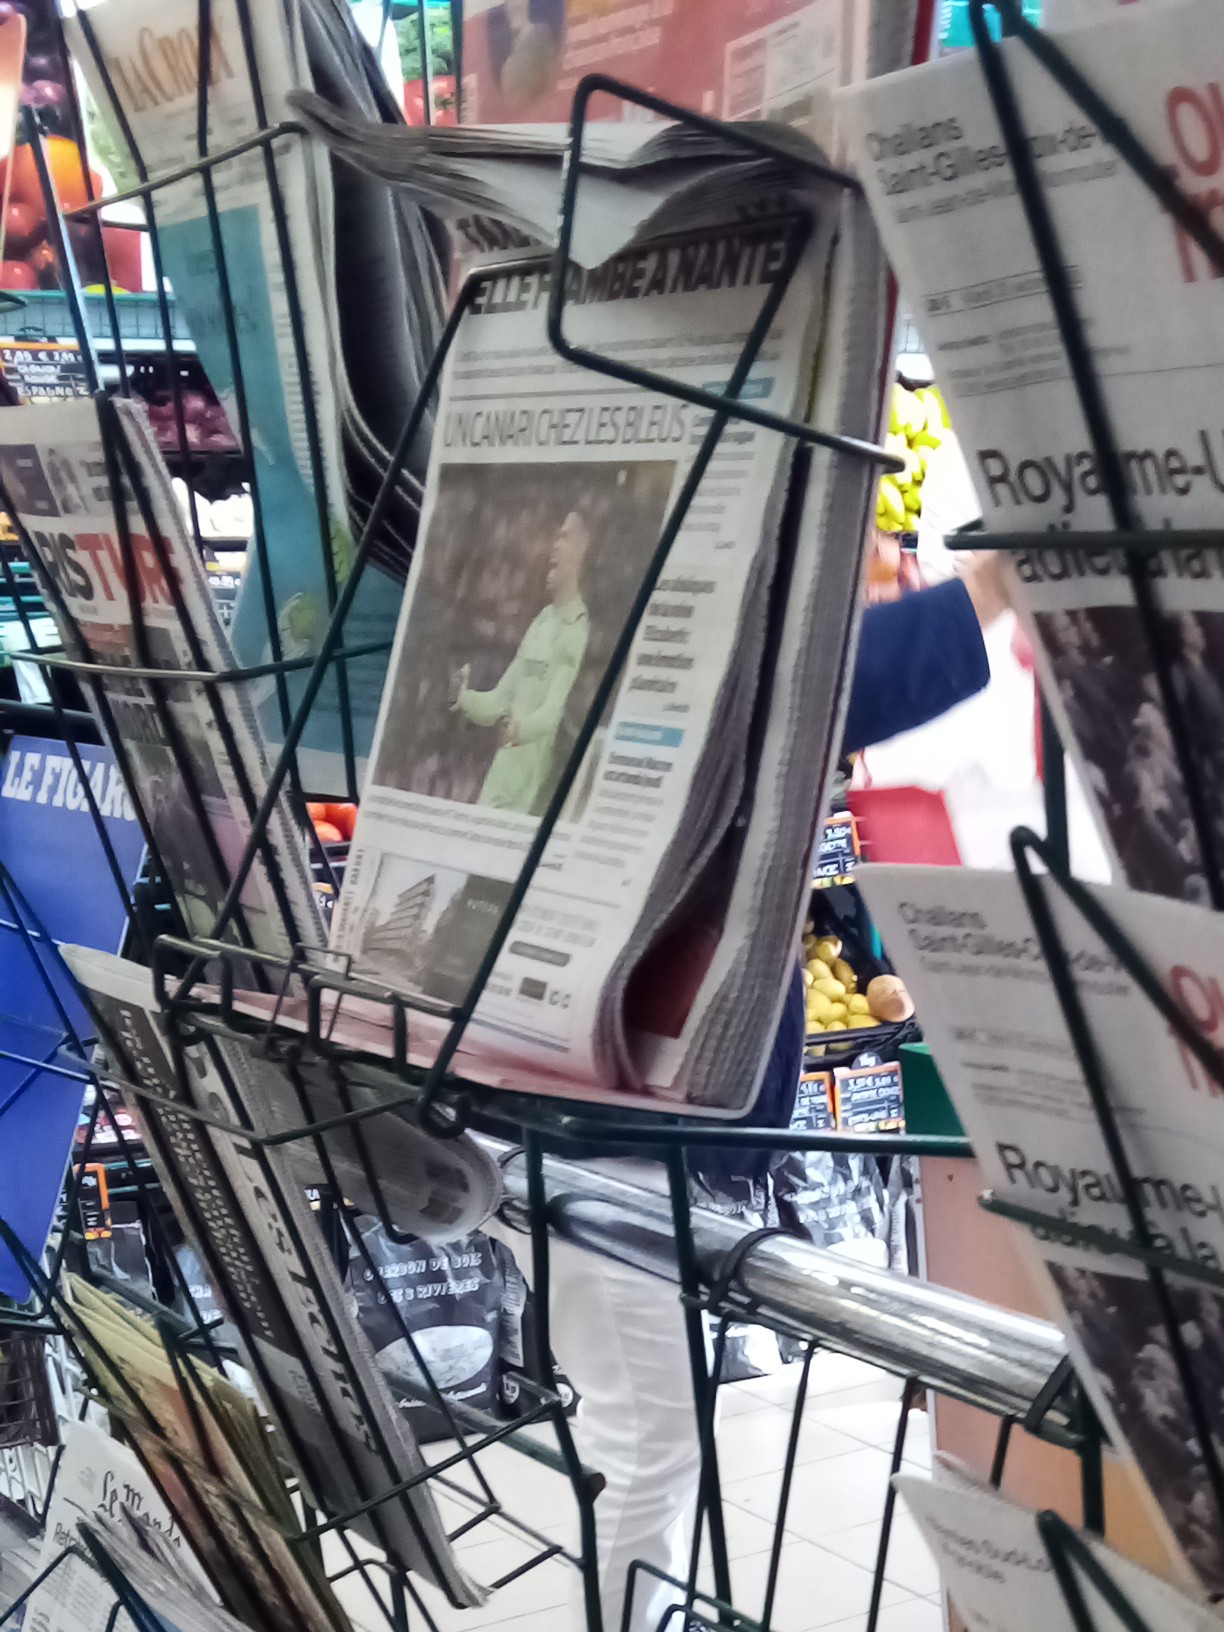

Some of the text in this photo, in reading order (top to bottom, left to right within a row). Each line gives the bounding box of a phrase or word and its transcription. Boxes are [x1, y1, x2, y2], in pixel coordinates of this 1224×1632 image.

[535, 404, 583, 444] CHEZ
[621, 404, 689, 441] BLEUS
[1, 750, 42, 802] LE
